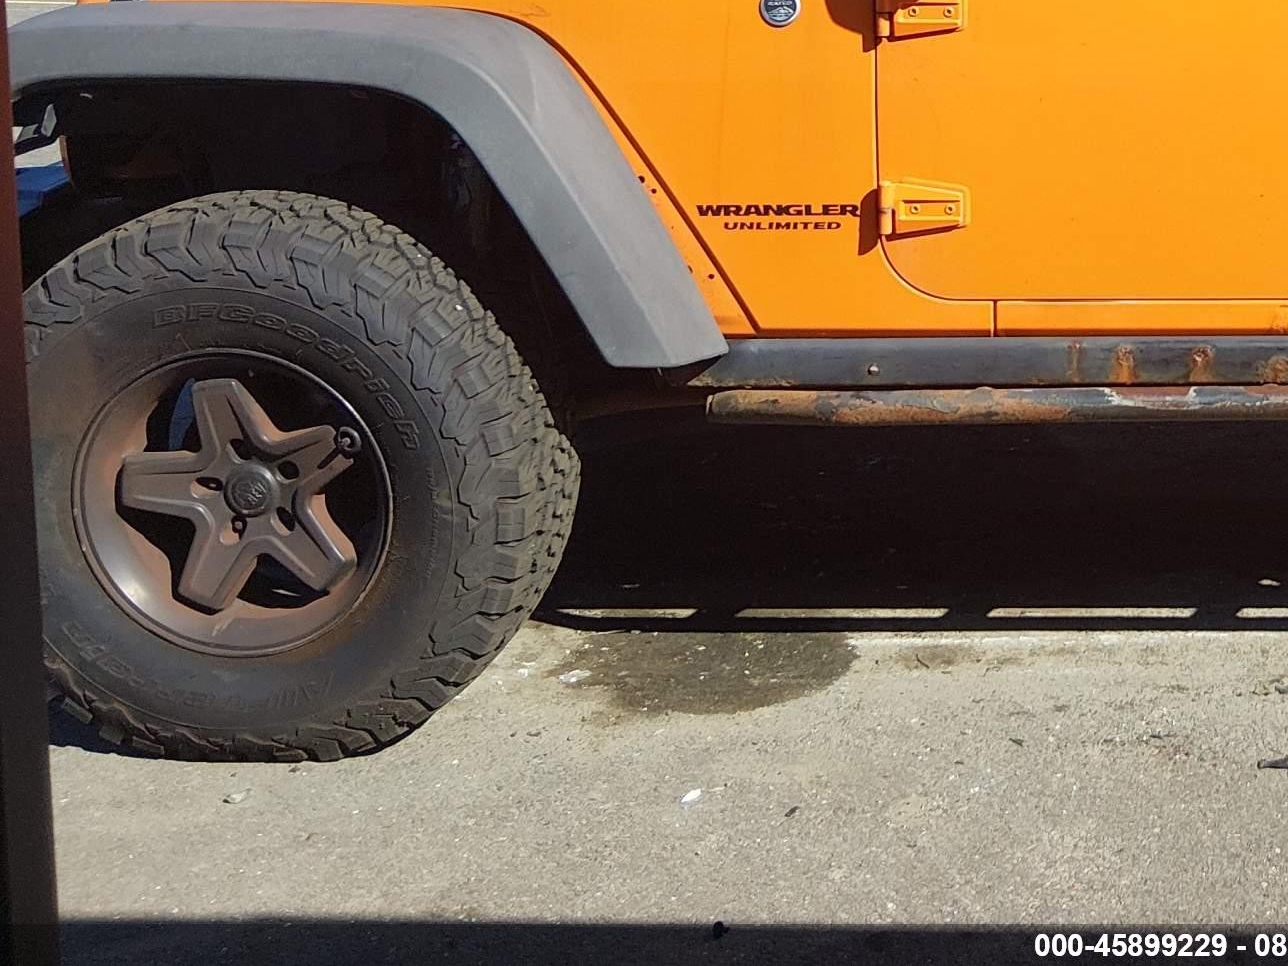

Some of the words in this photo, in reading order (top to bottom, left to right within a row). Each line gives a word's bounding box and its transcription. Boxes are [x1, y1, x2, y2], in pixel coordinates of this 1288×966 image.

[696, 204, 861, 218] WRANGLER
[723, 221, 842, 231] UNLIMITED
[153, 302, 420, 450] BFGoodrich
